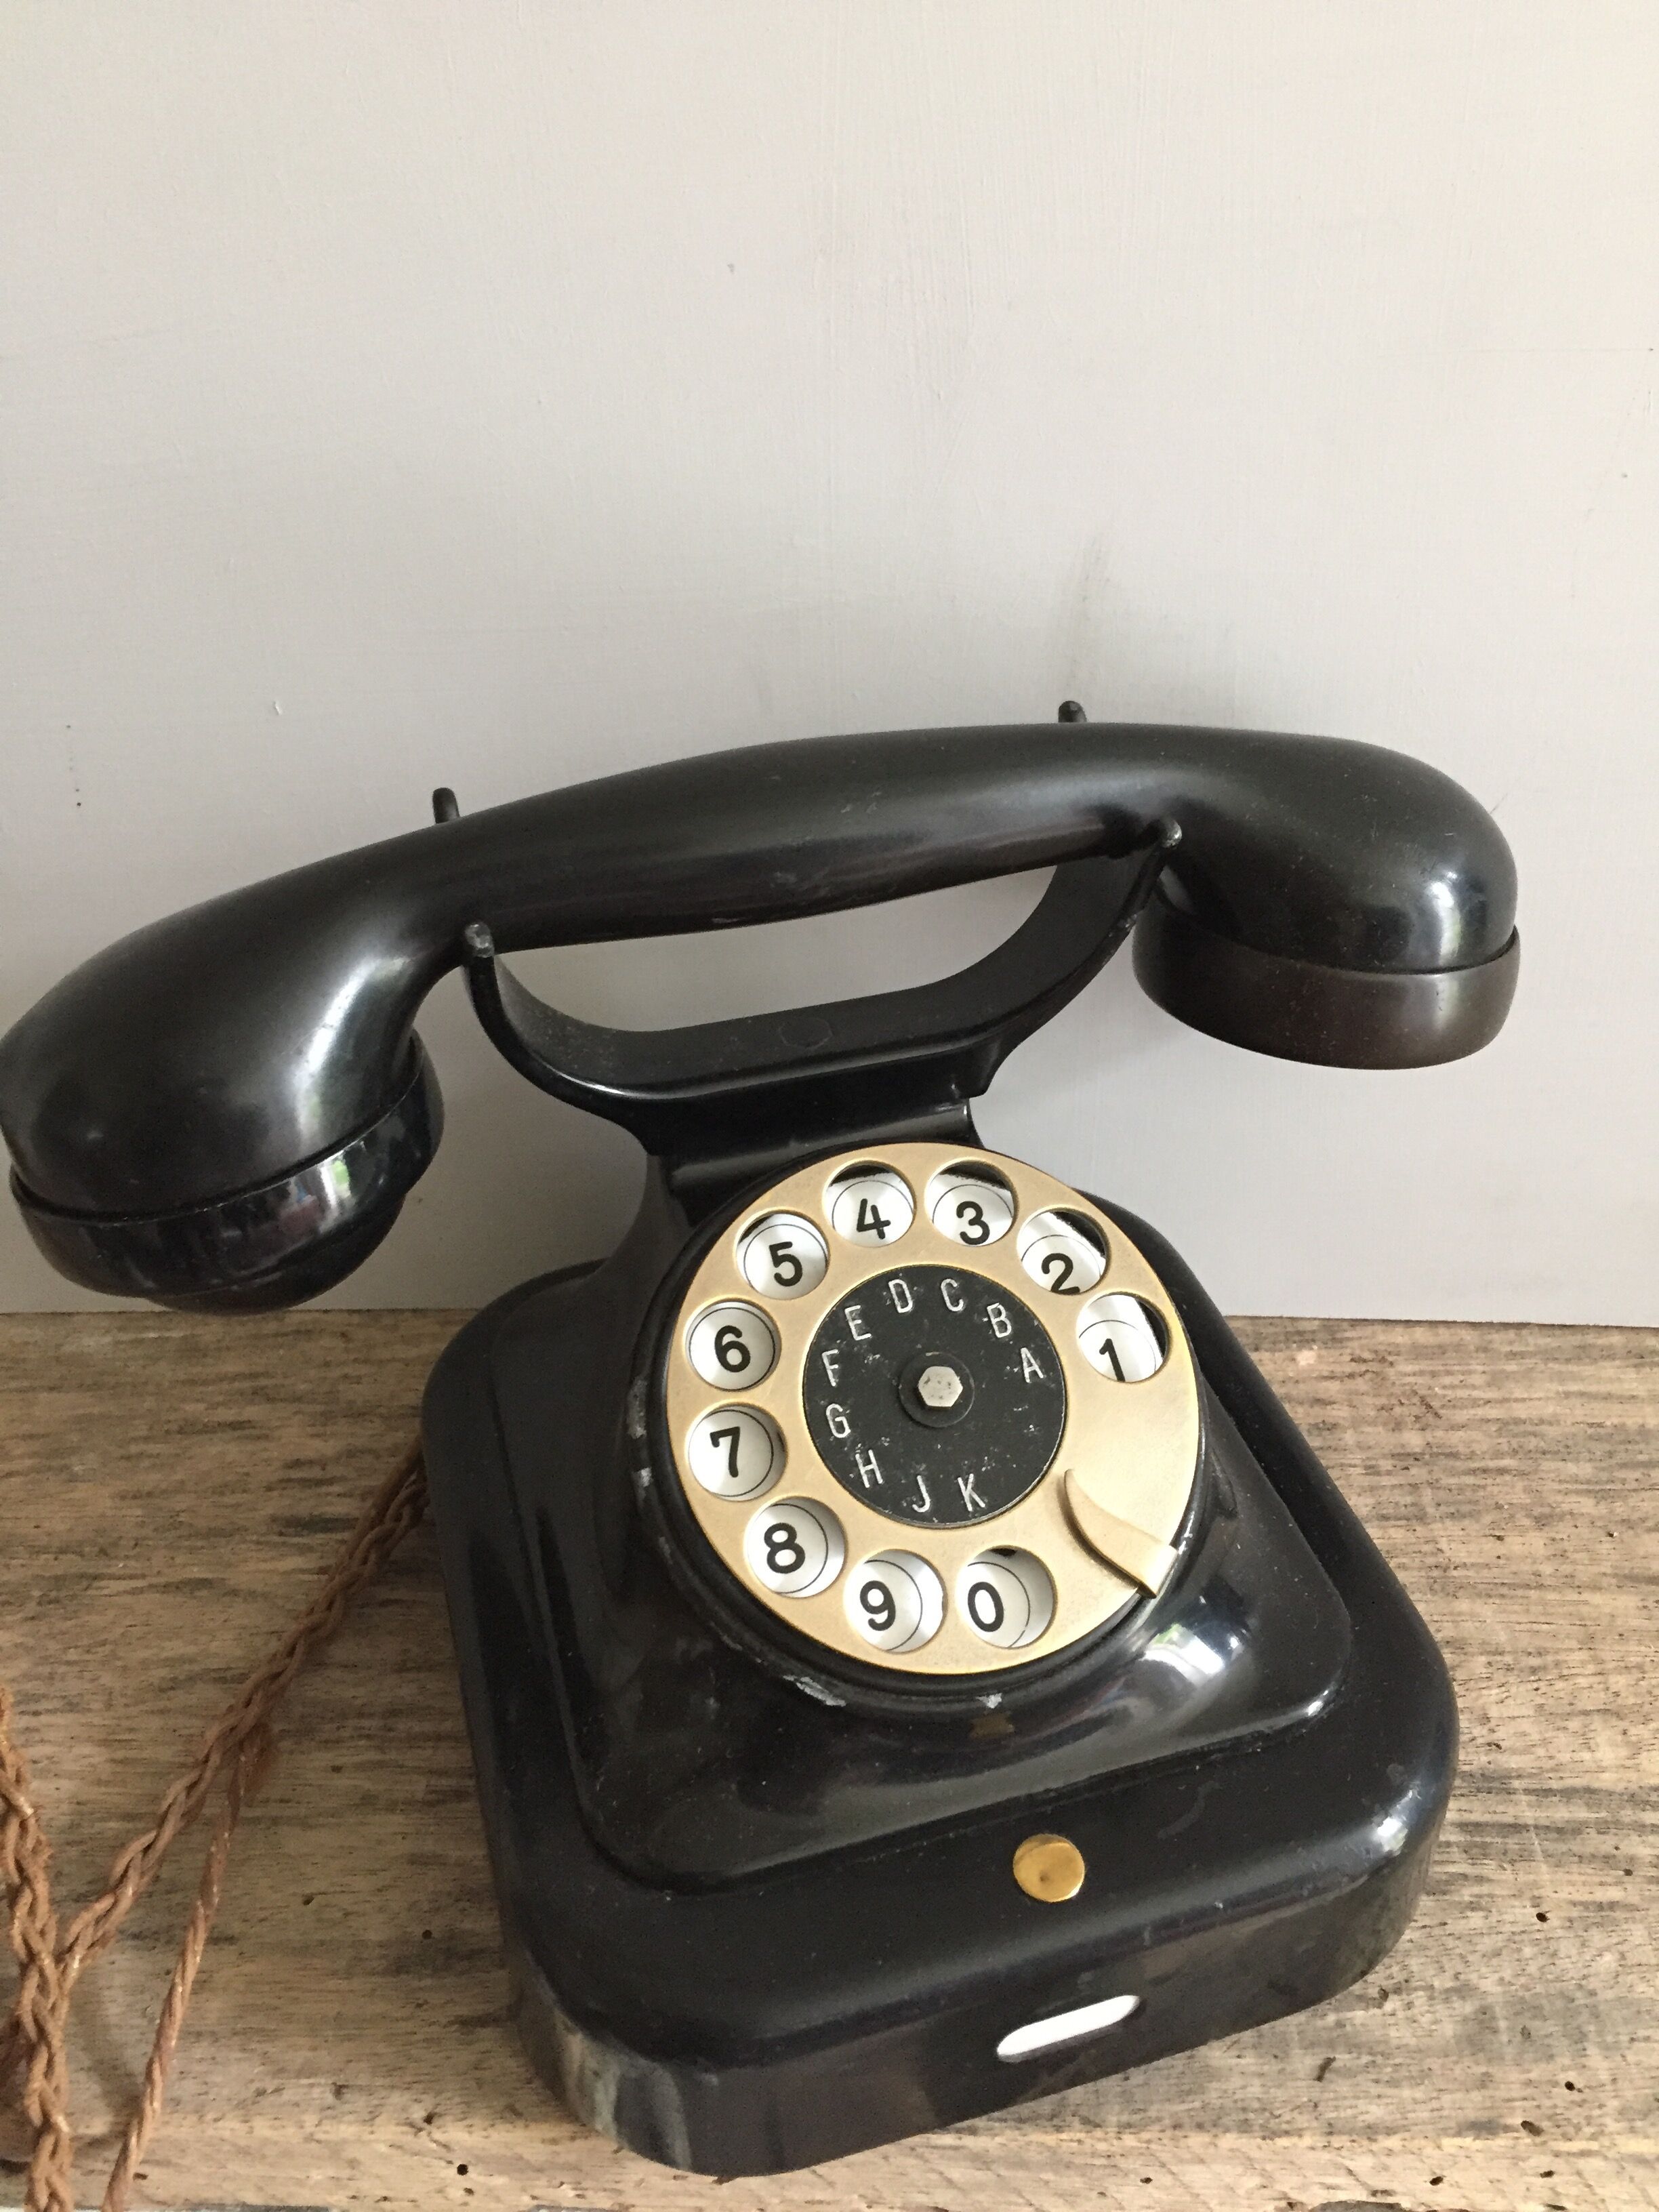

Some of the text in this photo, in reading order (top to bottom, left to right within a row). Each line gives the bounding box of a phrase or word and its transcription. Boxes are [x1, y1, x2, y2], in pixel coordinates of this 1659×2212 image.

[856, 1198, 891, 1240] 4
[956, 1201, 990, 1245] 3
[769, 1241, 803, 1287] 5
[1042, 1252, 1080, 1293] 2
[888, 1279, 914, 1313] D
[941, 1278, 964, 1311] C
[844, 1305, 872, 1341] E
[986, 1303, 1012, 1338] B
[714, 1325, 751, 1372] 6
[822, 1349, 839, 1387] F
[1020, 1348, 1044, 1383] A
[1099, 1338, 1125, 1382] 1
[825, 1403, 851, 1438] G
[710, 1426, 741, 1478] 7
[855, 1449, 884, 1488] H
[912, 1475, 930, 1513] J
[958, 1473, 986, 1511] K
[764, 1522, 805, 1574] 8
[859, 1580, 896, 1631] 9
